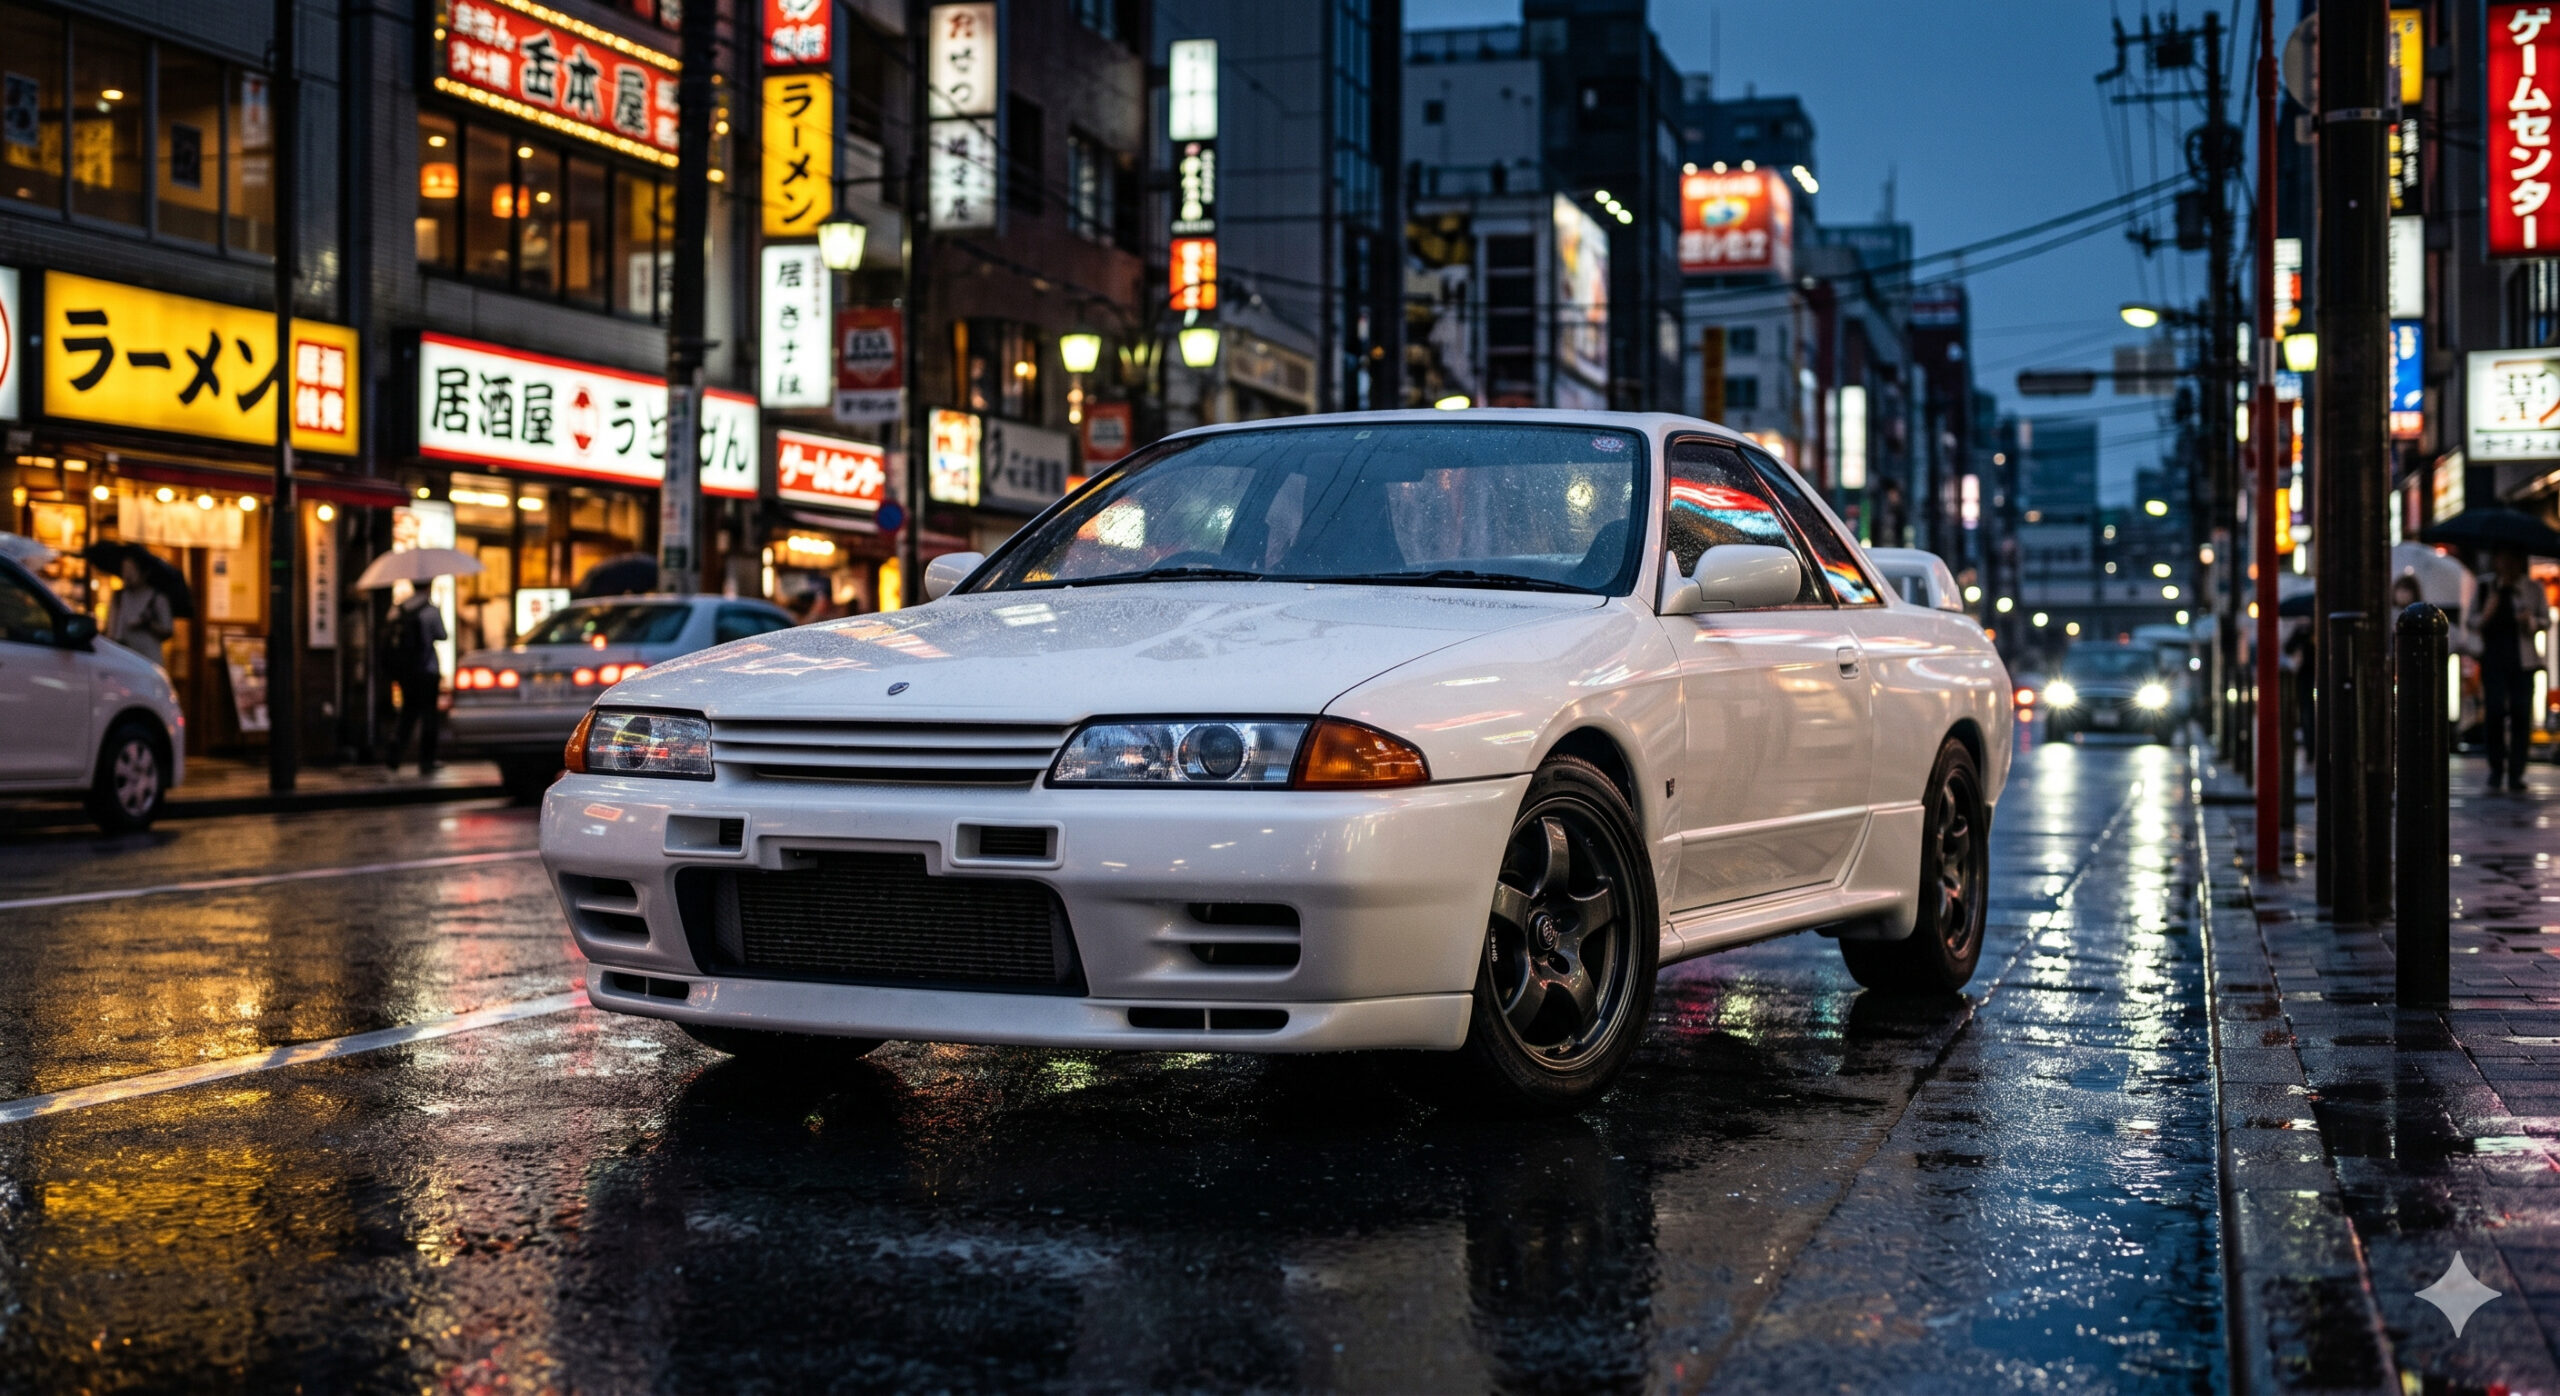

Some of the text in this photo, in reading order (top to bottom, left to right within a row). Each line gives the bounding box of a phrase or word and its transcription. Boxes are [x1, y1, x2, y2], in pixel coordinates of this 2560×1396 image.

[782, 82, 814, 225] ラーメン
[2508, 8, 2552, 250] ゲームセンター
[62, 309, 278, 412] ラーメン
[432, 367, 555, 446] 居酒屋
